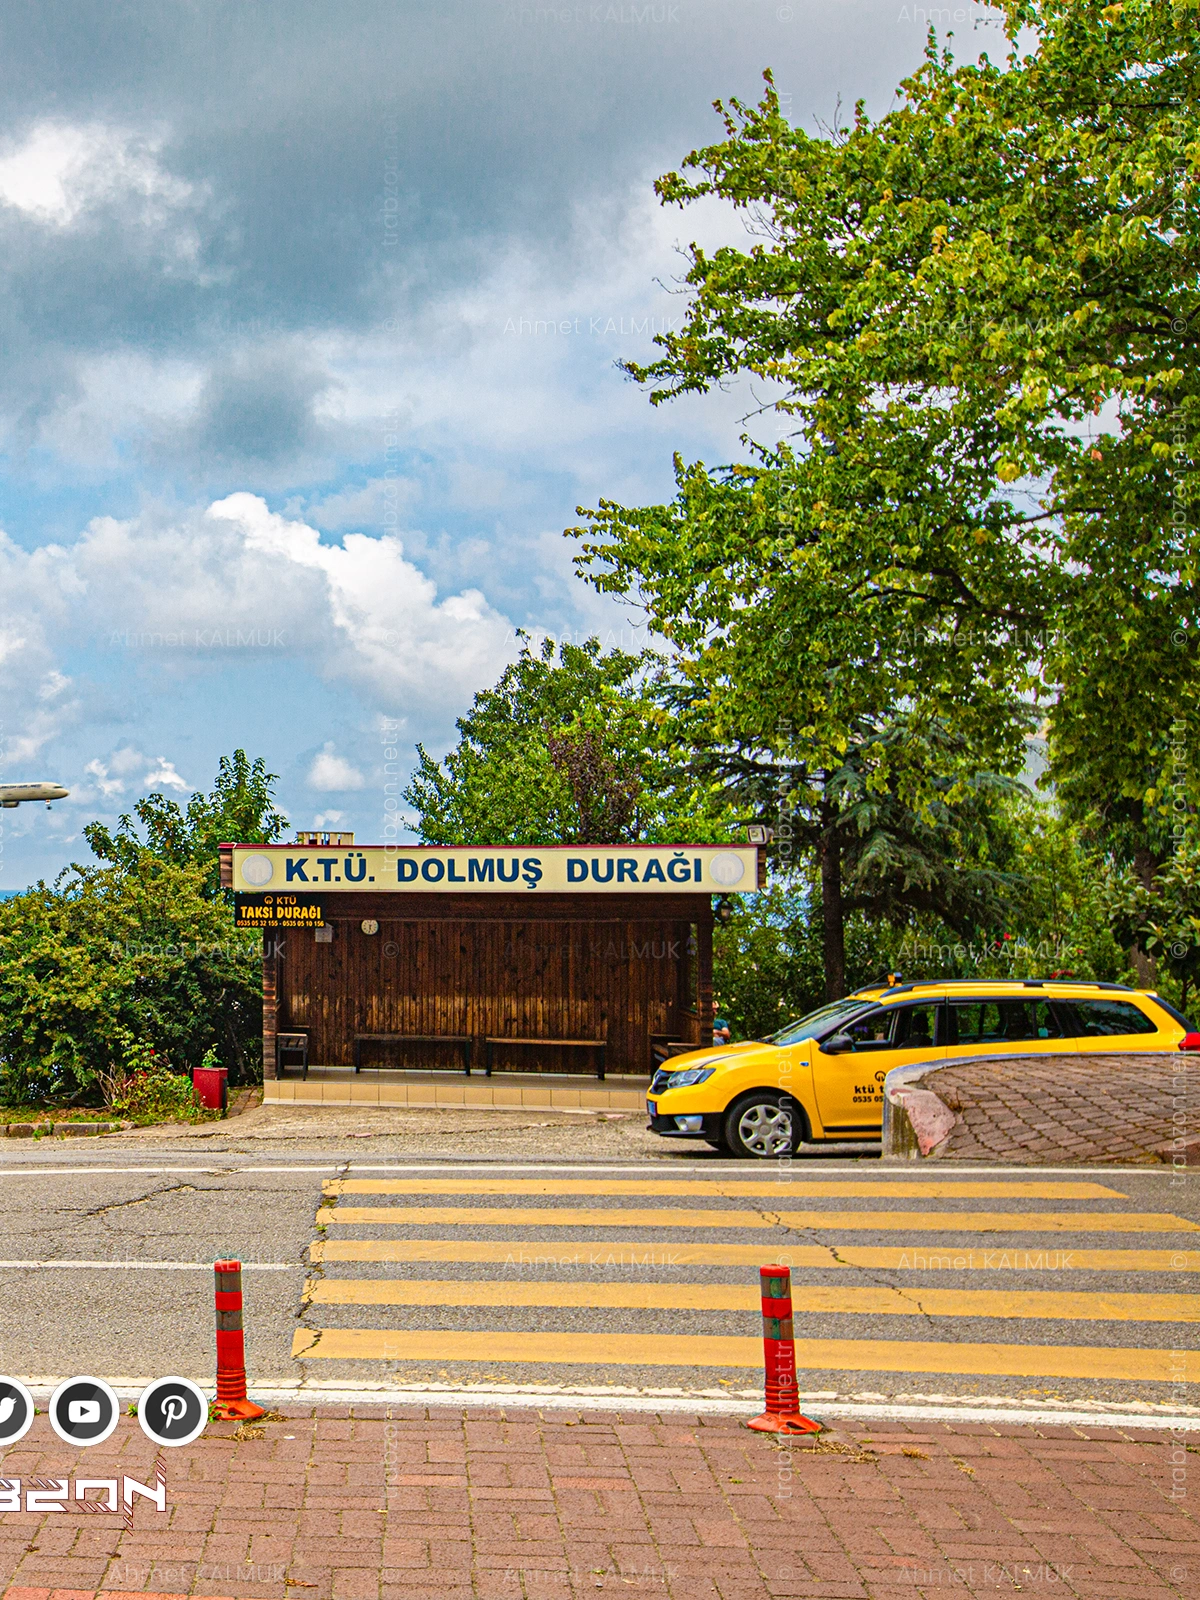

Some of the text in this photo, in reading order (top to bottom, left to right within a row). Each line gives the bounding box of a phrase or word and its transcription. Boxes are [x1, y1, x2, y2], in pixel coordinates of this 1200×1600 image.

[285, 852, 702, 889] K.T.Ü. DOLMUŞ DURAĞI
[276, 895, 297, 905] KTÜ
[276, 905, 321, 919] DURAĞI
[854, 1085, 875, 1094] ktü
